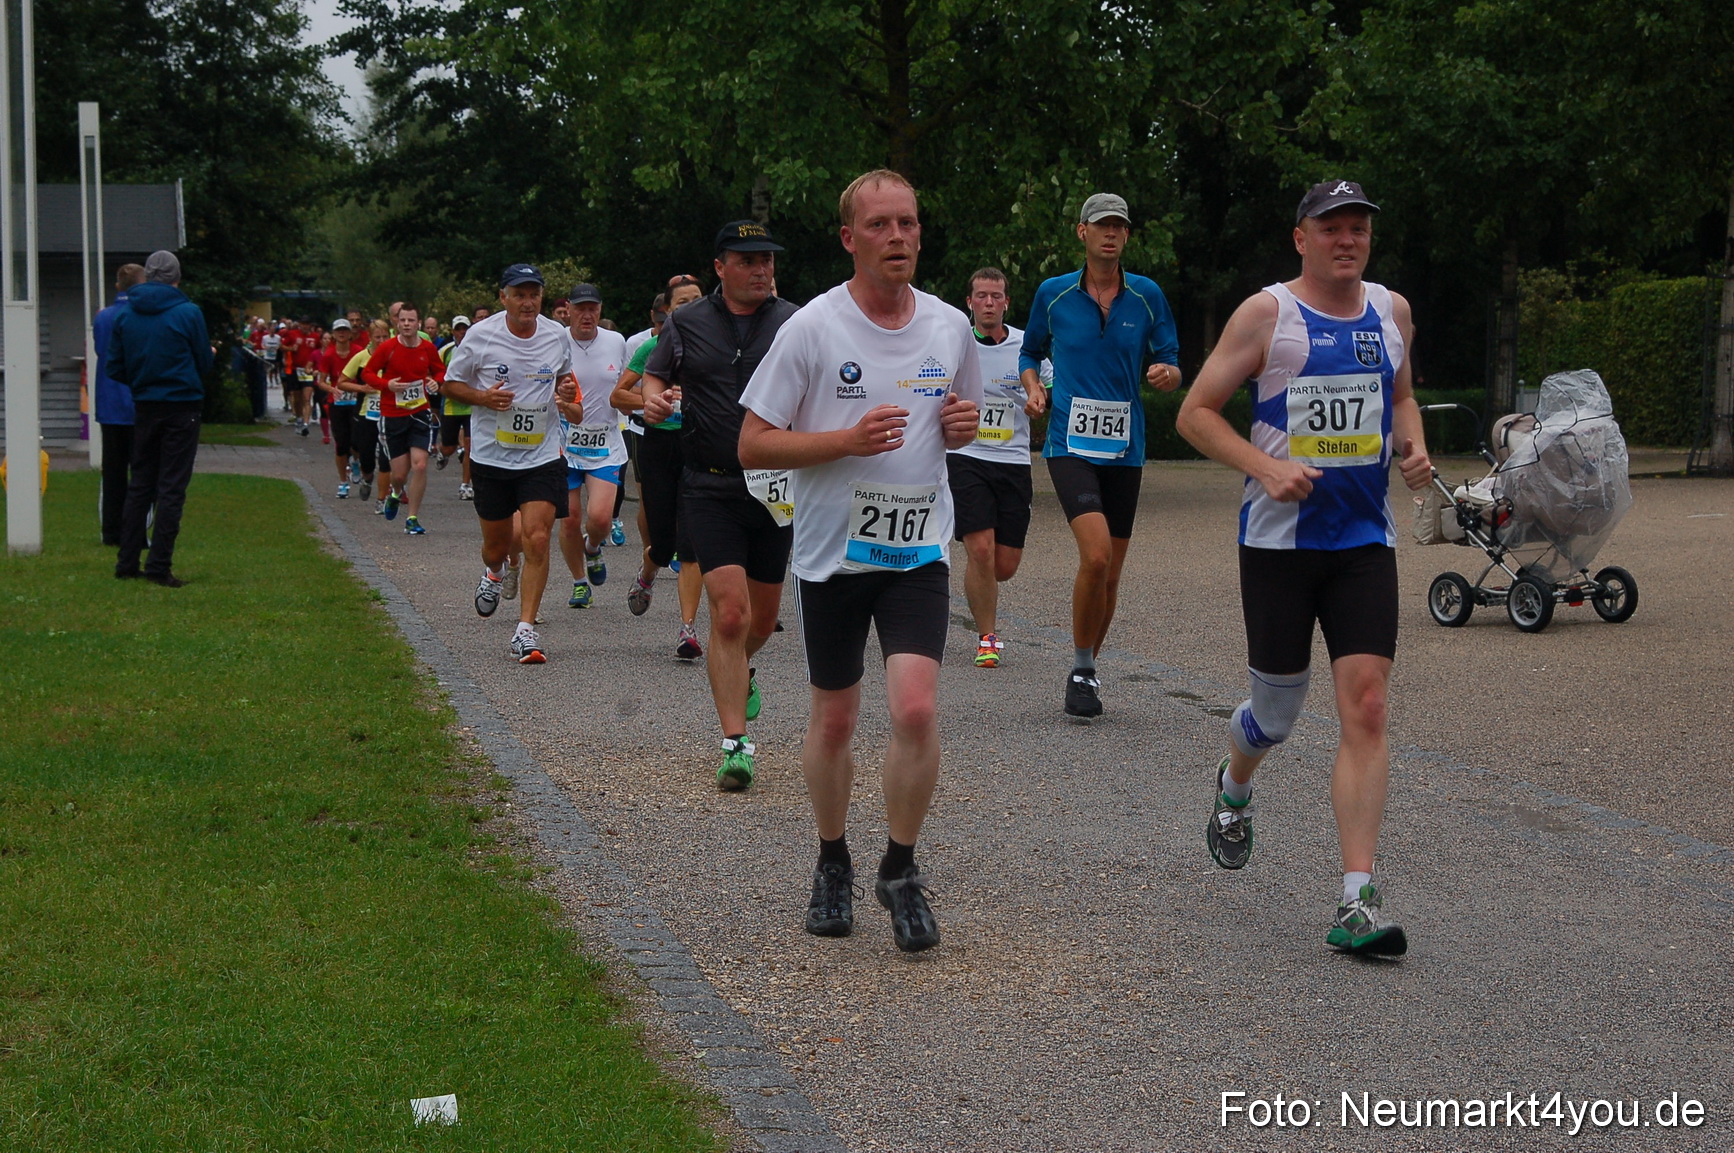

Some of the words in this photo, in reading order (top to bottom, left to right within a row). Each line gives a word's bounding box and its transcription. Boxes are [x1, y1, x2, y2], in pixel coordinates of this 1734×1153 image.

[1355, 332, 1377, 340] ESV
[836, 386, 867, 394] PARTL
[896, 379, 912, 388] 14.
[1289, 385, 1322, 396] PARTL
[1323, 384, 1366, 394] Neumarkt
[1072, 403, 1093, 412] PARTL
[1094, 406, 1122, 414] Neumarkt
[1307, 397, 1365, 432] 307
[512, 413, 534, 432] 85
[983, 408, 1005, 427] 47
[1074, 412, 1125, 437] 3154
[570, 431, 606, 447] 2346
[978, 430, 1001, 439] homas
[1317, 440, 1358, 454] Stefan
[746, 472, 770, 482] PARTL
[767, 476, 788, 503] 57
[854, 489, 888, 503] PARTL
[891, 494, 927, 504] Neumarkt
[858, 505, 931, 543] 2167
[869, 547, 919, 566] Manfred
